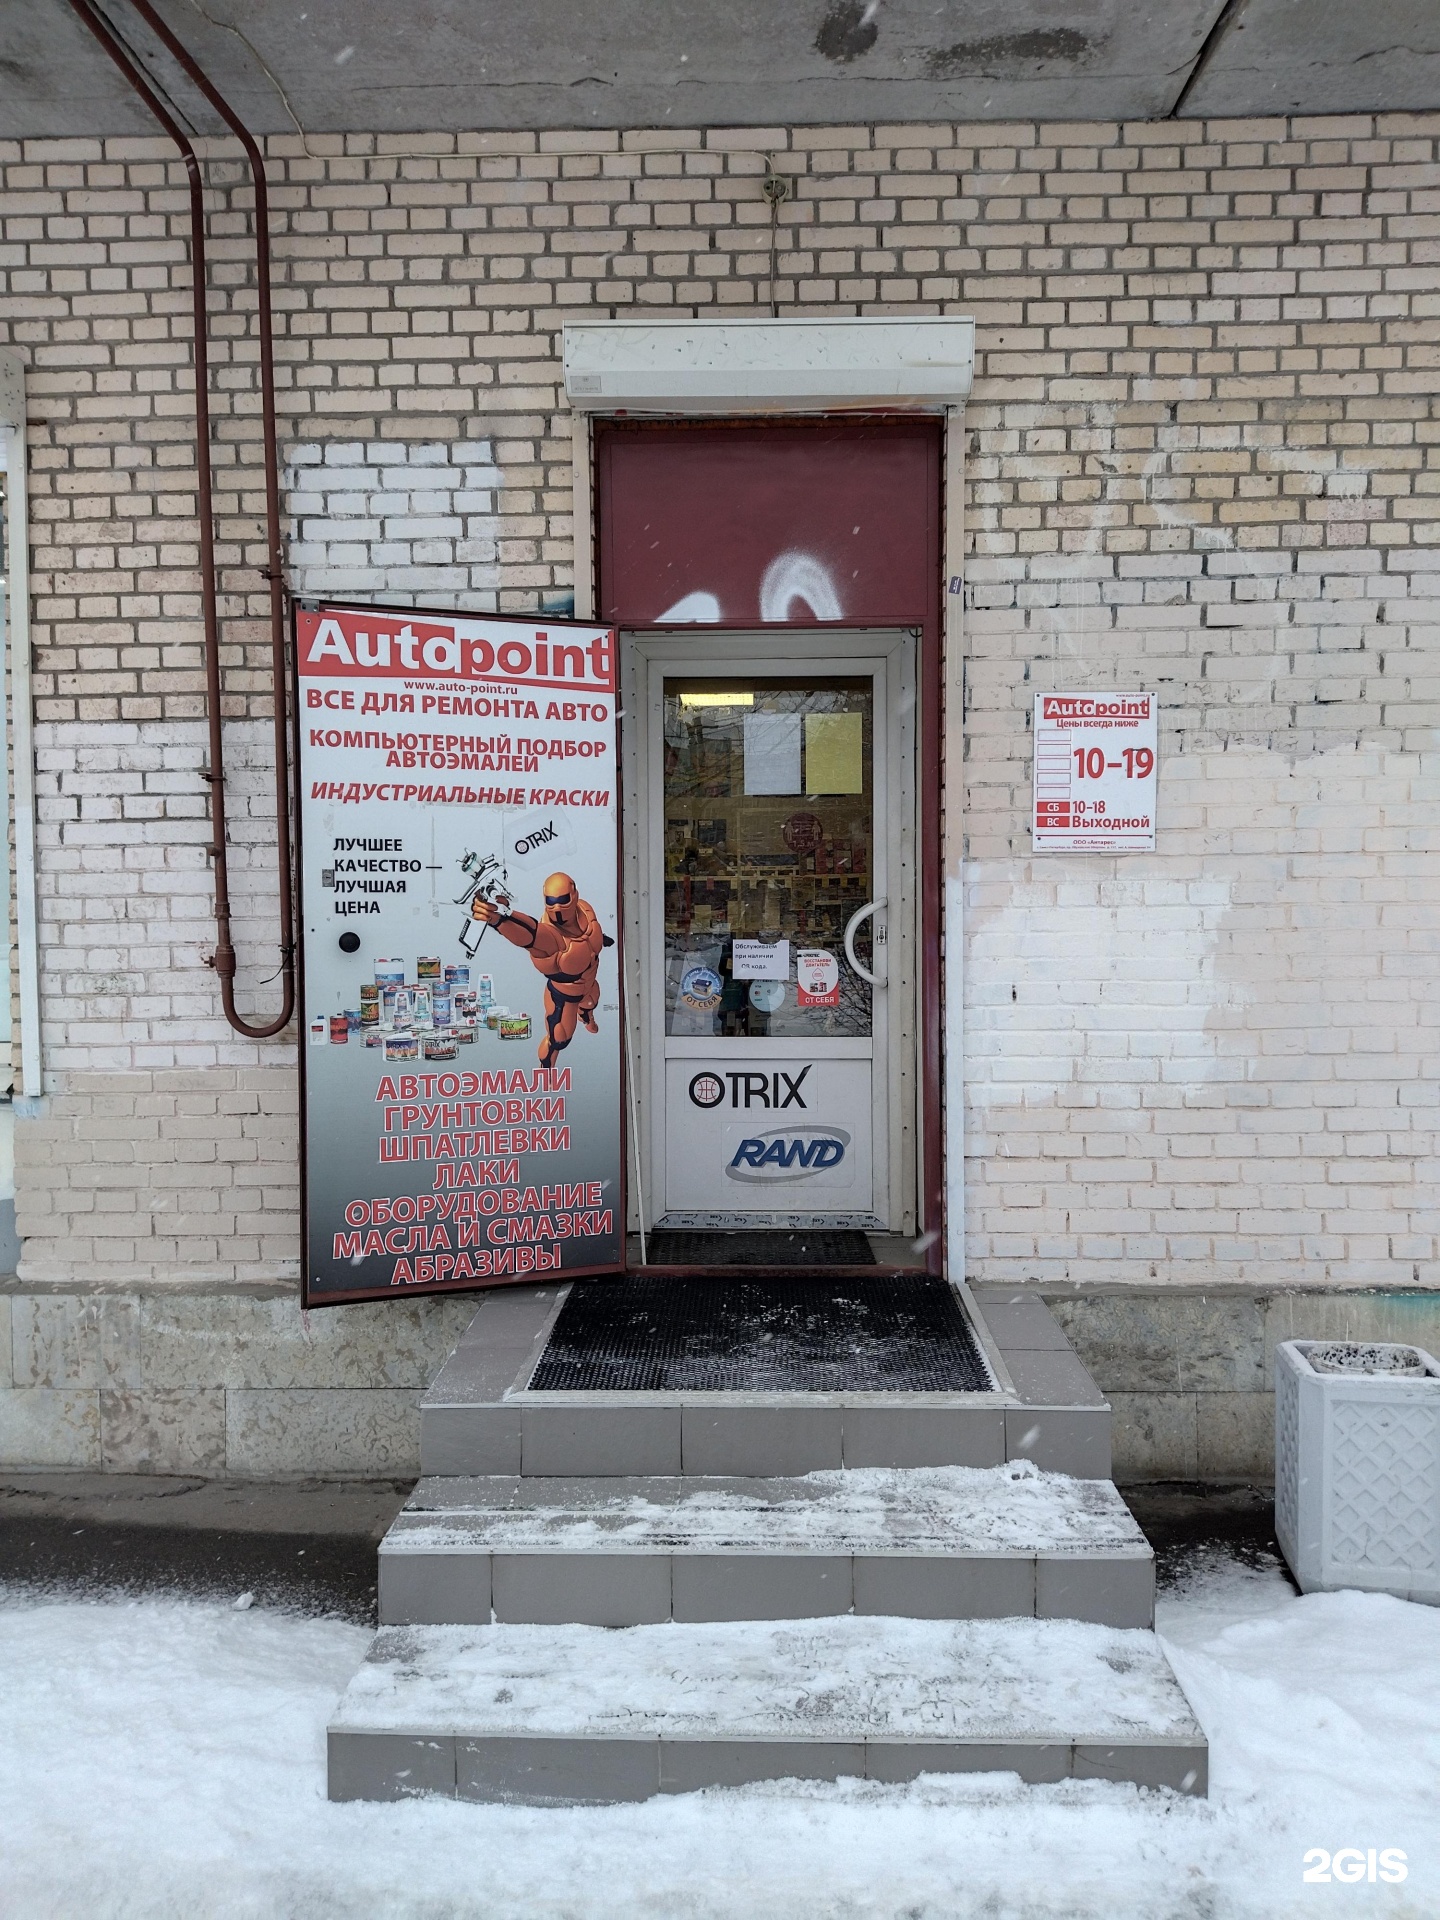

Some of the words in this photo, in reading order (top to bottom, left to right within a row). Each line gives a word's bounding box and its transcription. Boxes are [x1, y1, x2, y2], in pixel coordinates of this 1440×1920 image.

[306, 619, 612, 680] Autopoint
[404, 679, 518, 695] www.auto-point.ru
[306, 688, 355, 709] ВСЕ
[361, 692, 414, 715] ДЛЯ
[422, 695, 539, 719] РЕМОНТА
[545, 701, 608, 722] АВТО
[1047, 700, 1148, 715] Autopoint
[1056, 719, 1082, 729] Цены
[1084, 720, 1113, 729] всегда
[310, 729, 512, 755] КОМПЬЮТЕРНЫЙ
[518, 737, 606, 759] ПОДБОР
[386, 750, 539, 773] АВТОЭМАЛЕЙ
[310, 782, 525, 805] ИНДУСТРИАЛЬНЫЕ
[530, 788, 610, 806] КРАСКИ
[1047, 803, 1060, 811] СБ
[1047, 818, 1060, 826] ВС
[1072, 815, 1150, 830] Выходной
[334, 838, 402, 852] ЛУЧШЕЕ
[515, 820, 558, 854] OTRIX
[334, 860, 422, 872] КАЧЕСТВО
[334, 880, 406, 894] ЛУЧШАЯ
[335, 901, 381, 916] ЦЕНА
[686, 996, 698, 1005] ОТ
[698, 996, 718, 1007] СЕБЯ
[804, 996, 814, 1004] ОТ
[374, 1067, 572, 1102] АВТОЭМАЛИ
[688, 1064, 812, 1108] OTRIX
[384, 1096, 566, 1132] ГРУНТОВКИ
[378, 1126, 571, 1163] ШПАТЛЕВКИ
[730, 1139, 845, 1168] RAND
[432, 1158, 520, 1190] ЛАКИ
[344, 1181, 602, 1227] ОБОРУДОВАНИЕ
[332, 1223, 451, 1260] МАСЛА
[458, 1221, 480, 1248] И
[486, 1210, 614, 1245] СМАЗКИ
[391, 1243, 562, 1286] АБРАЗИВЫ
